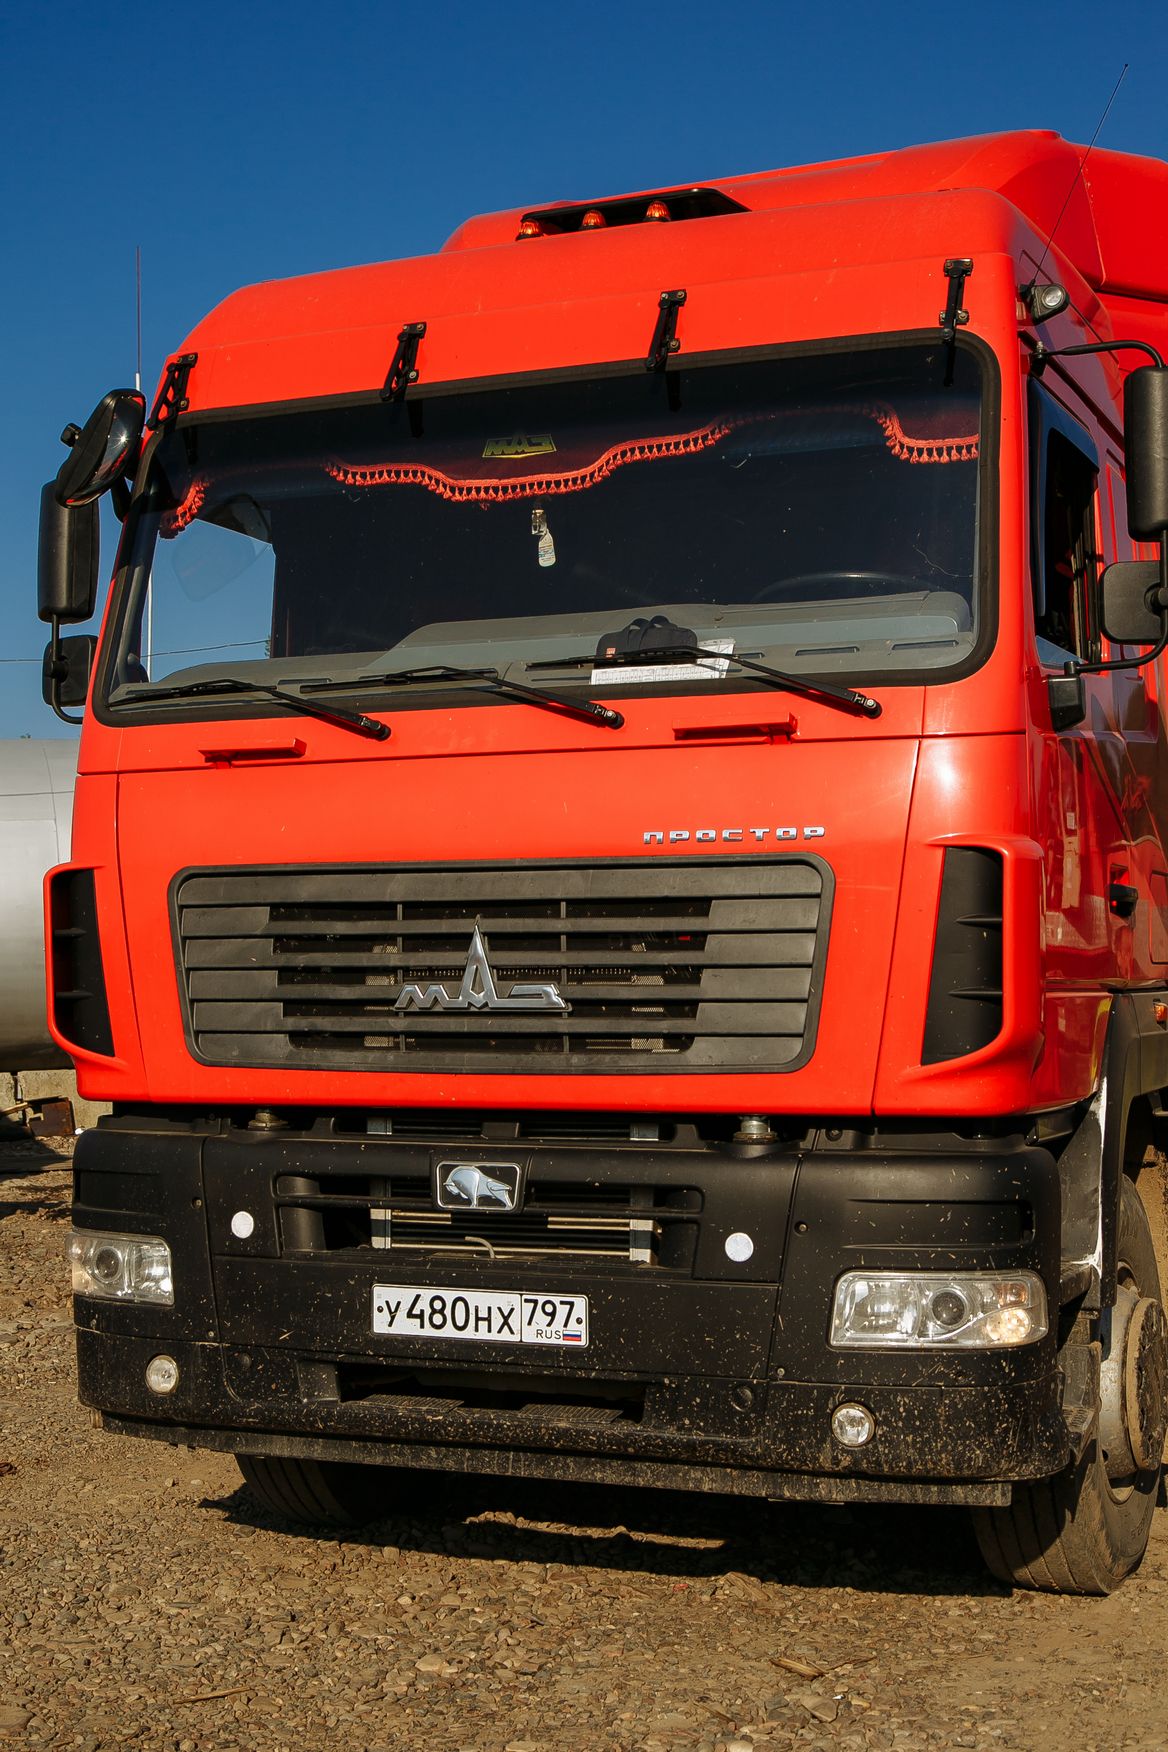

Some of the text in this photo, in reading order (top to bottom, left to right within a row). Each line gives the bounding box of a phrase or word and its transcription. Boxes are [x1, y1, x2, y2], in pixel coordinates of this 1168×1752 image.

[643, 826, 825, 845] ПРОСТОР
[394, 925, 570, 1010] МАЗ
[385, 1293, 575, 1335] У480НХ 797
[536, 1328, 562, 1340] RUS
